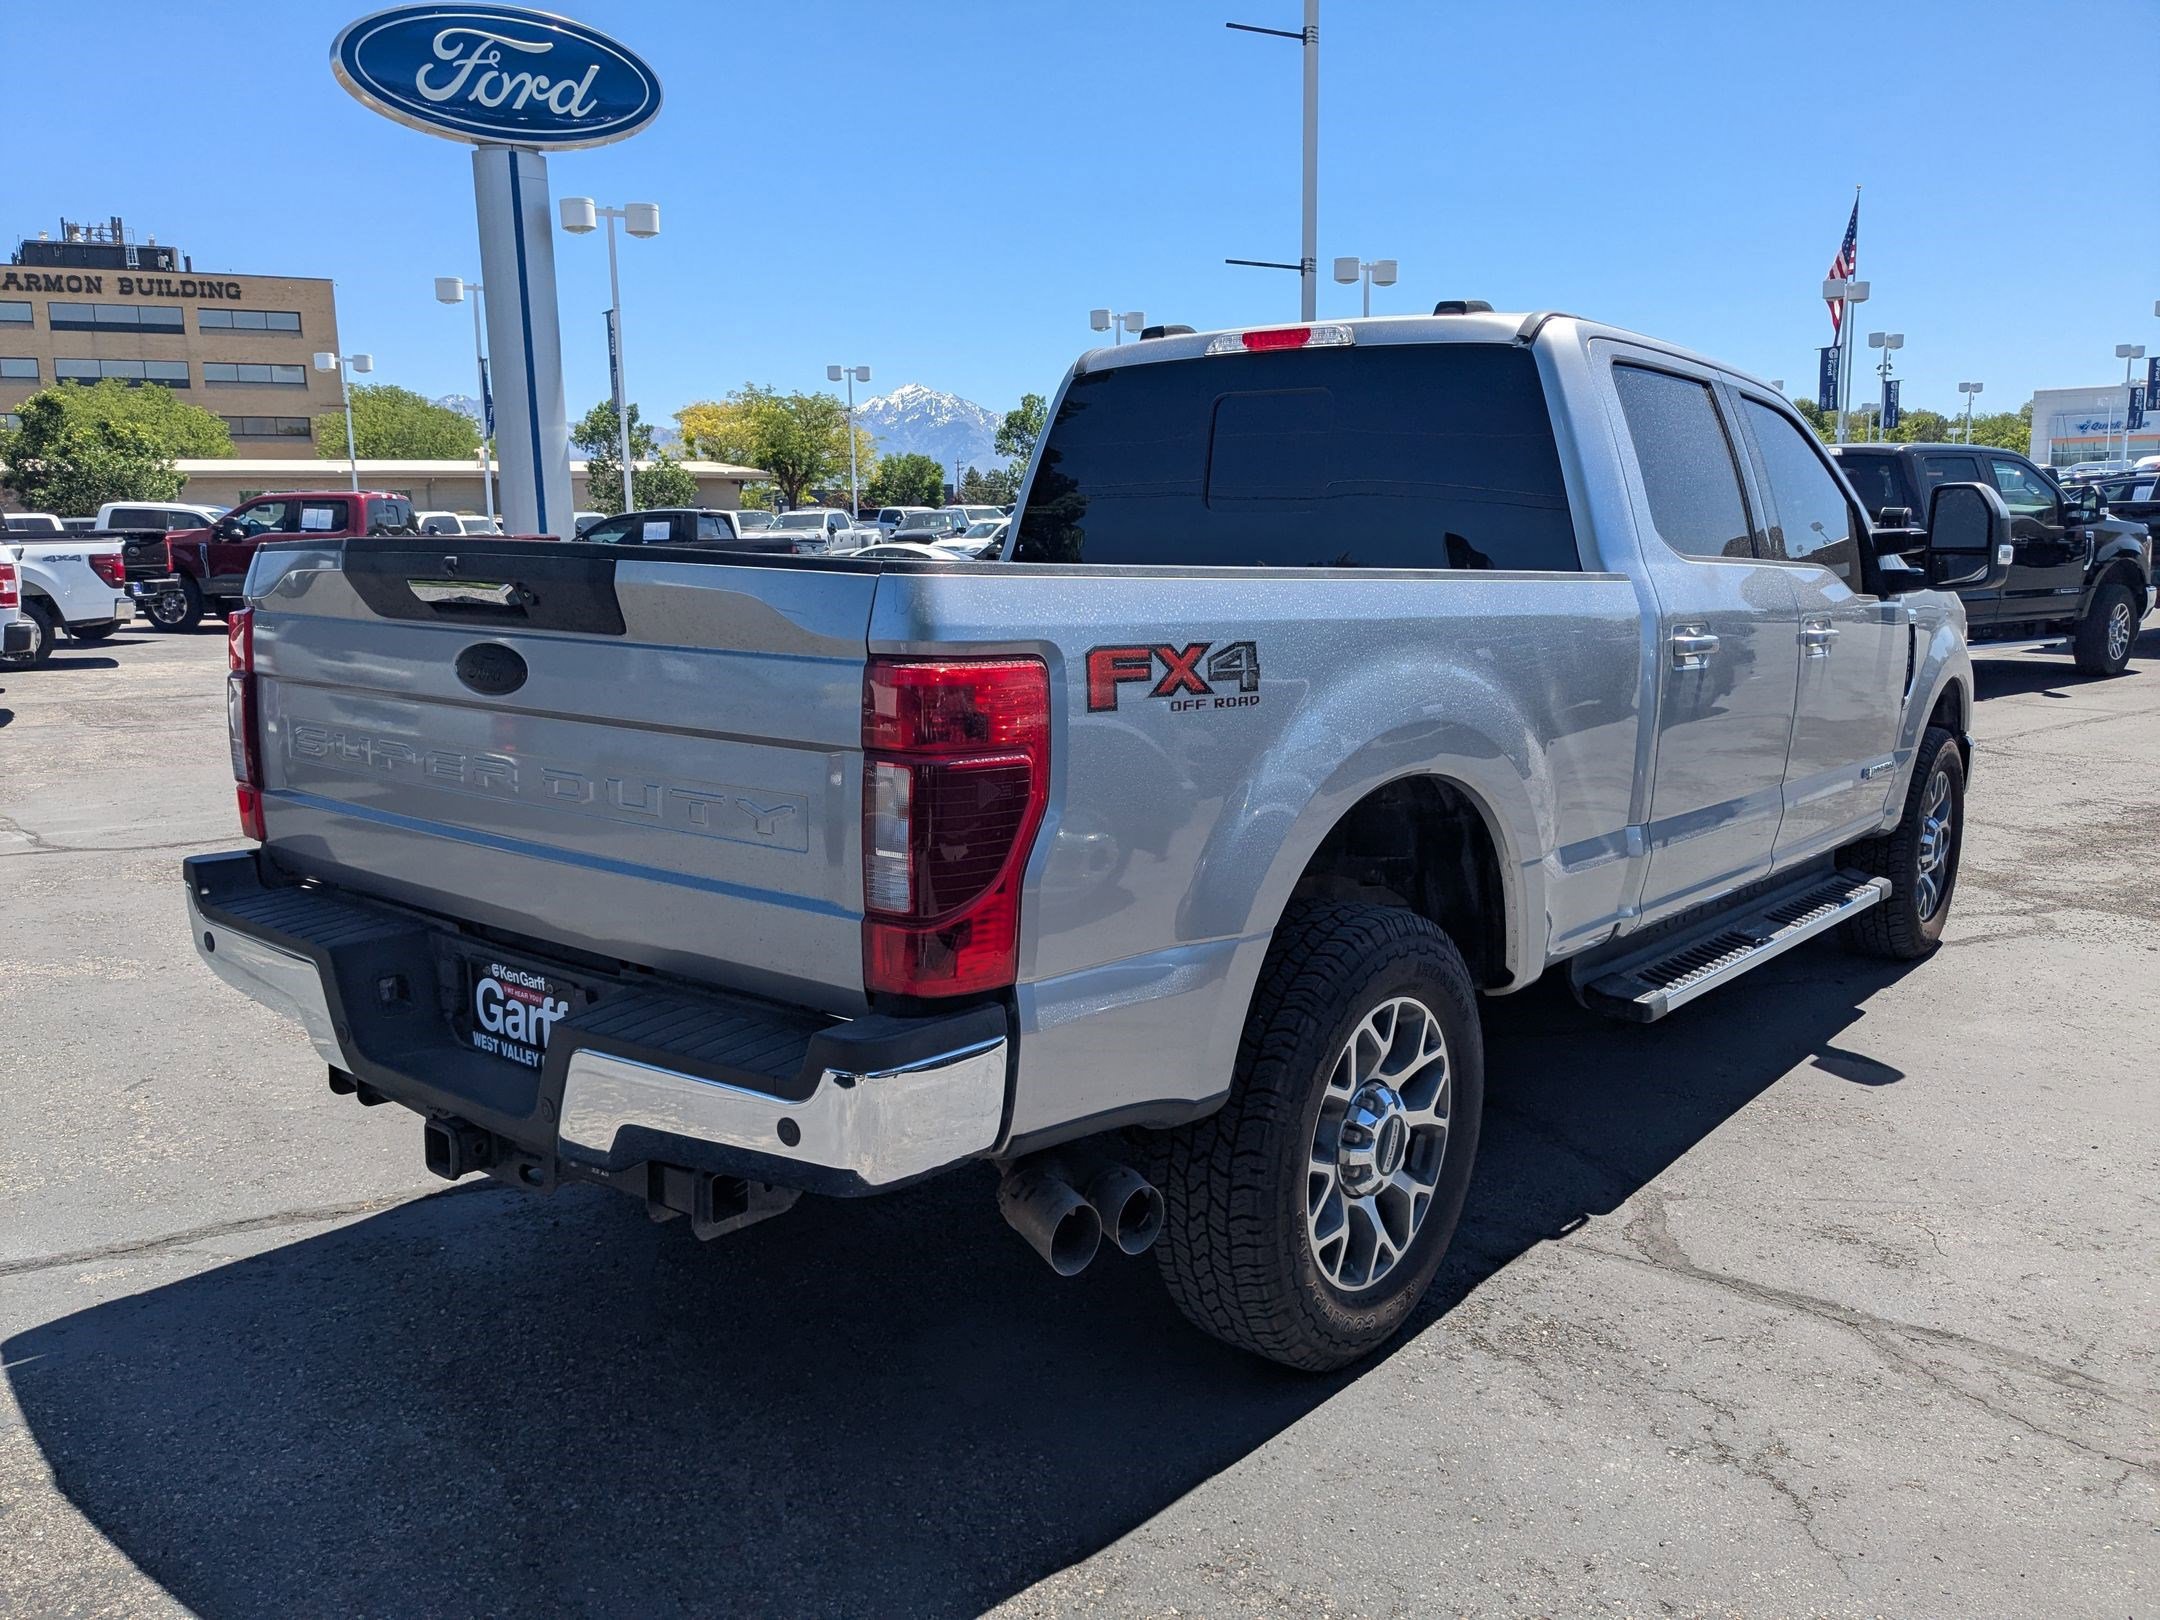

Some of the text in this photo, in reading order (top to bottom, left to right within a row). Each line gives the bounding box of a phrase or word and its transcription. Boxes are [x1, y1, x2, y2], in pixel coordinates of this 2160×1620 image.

[416, 28, 600, 117] Ford
[117, 277, 242, 300] BUILDING
[1085, 640, 1261, 713] FX4
[1170, 695, 1260, 713] OFF ROAD
[292, 726, 797, 837] SUPER DUTY
[472, 1031, 499, 1053] WEST
[500, 1040, 539, 1069] VALLEY
